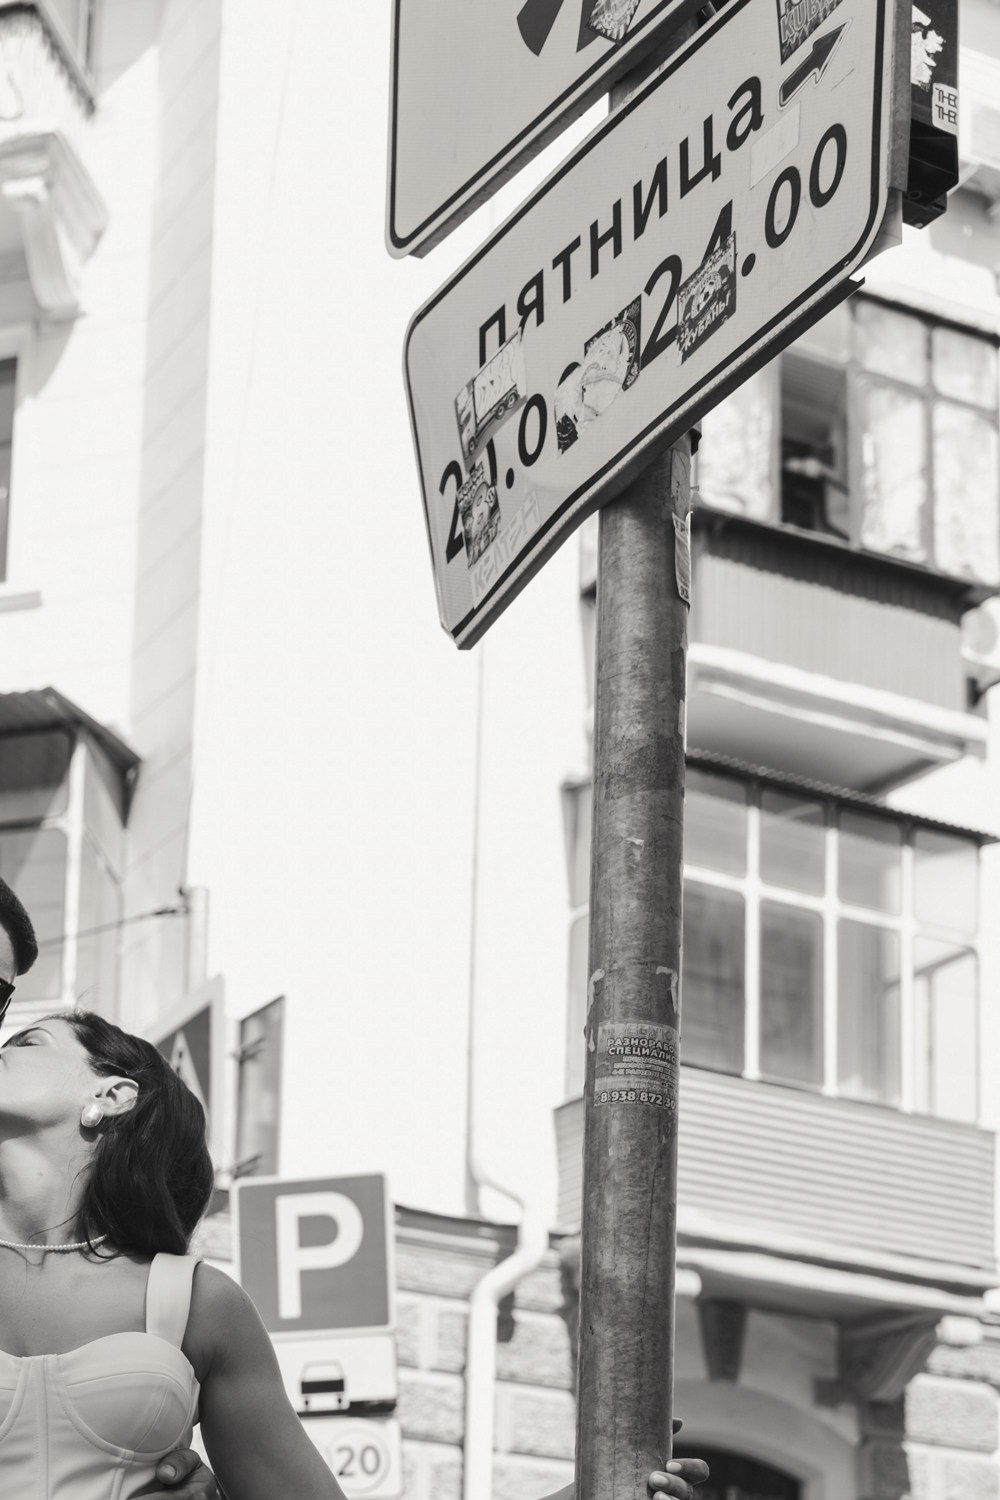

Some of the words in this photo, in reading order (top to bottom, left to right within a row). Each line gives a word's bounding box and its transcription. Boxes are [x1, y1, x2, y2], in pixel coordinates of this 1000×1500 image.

[600, 1091, 609, 1103] 8
[611, 1090, 637, 1102] 938
[640, 1091, 663, 1106] 872
[275, 1191, 364, 1319] P
[335, 1444, 381, 1477] 20
